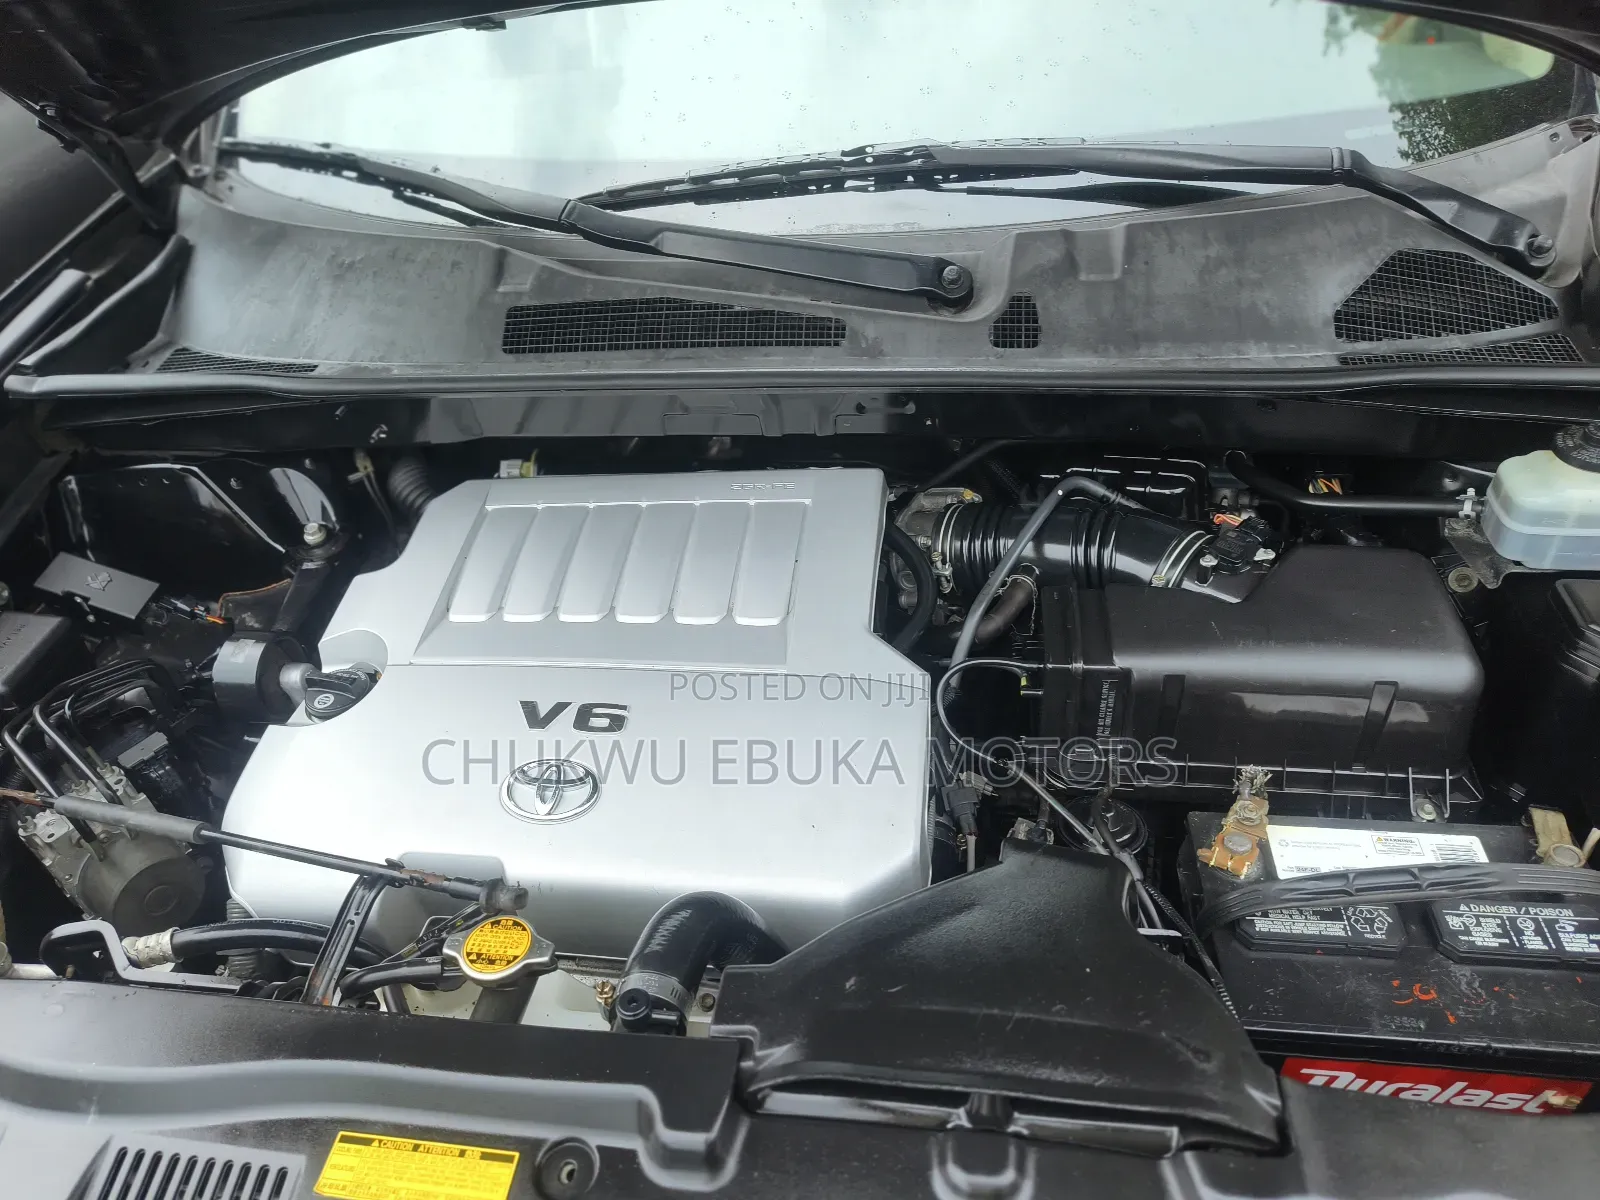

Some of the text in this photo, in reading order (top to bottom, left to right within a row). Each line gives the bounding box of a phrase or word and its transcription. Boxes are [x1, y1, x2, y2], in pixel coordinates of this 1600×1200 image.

[518, 700, 631, 736] V6
[1469, 903, 1574, 917] DANGER / POISON
[480, 953, 514, 961] ATTENTION
[1300, 1067, 1558, 1113] Duralast
[380, 1140, 414, 1151] CAUTION
[417, 1144, 461, 1157] ATTENTION
